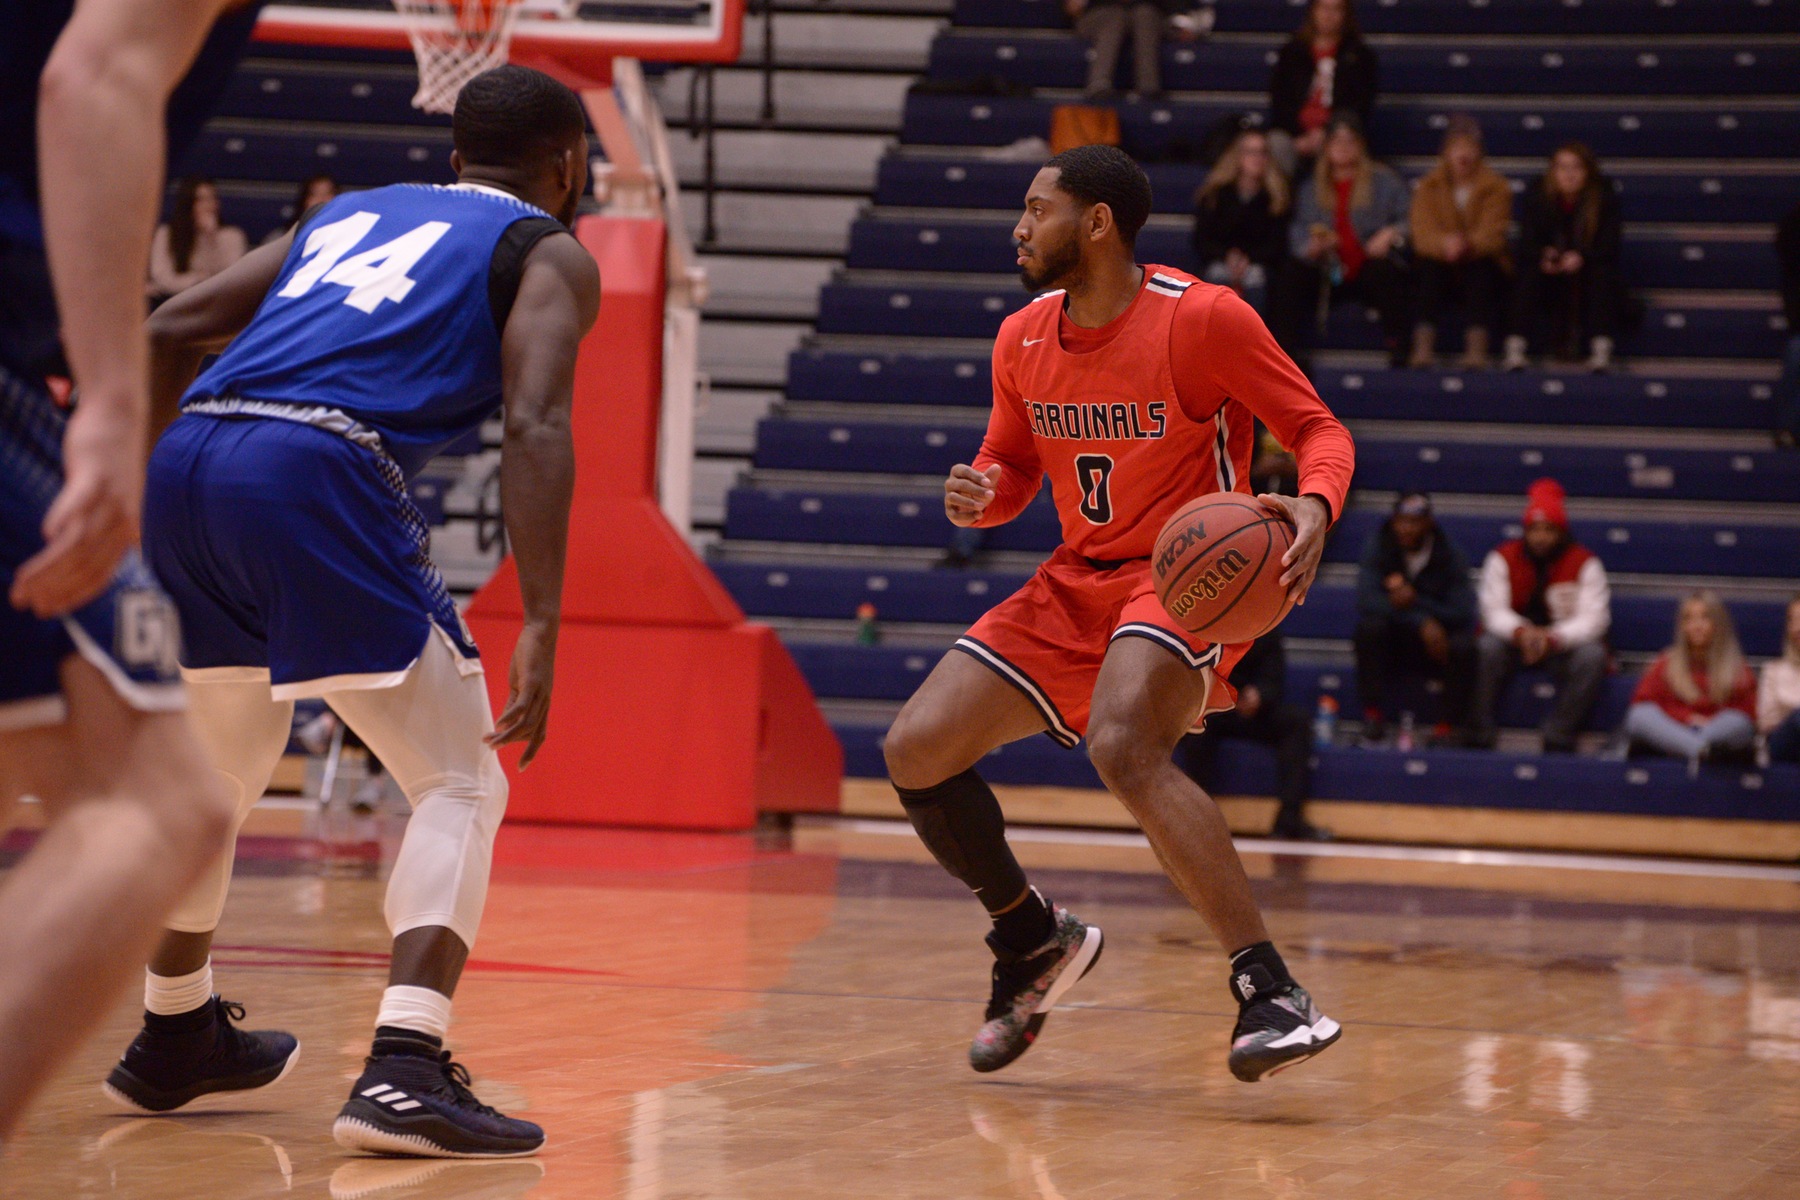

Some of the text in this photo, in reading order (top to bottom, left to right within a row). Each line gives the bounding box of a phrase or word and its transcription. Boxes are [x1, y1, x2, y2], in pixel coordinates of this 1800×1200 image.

[277, 210, 452, 315] 14
[1074, 453, 1114, 526] 0
[1156, 519, 1207, 581] NCAA
[1170, 547, 1250, 618] Wilson
